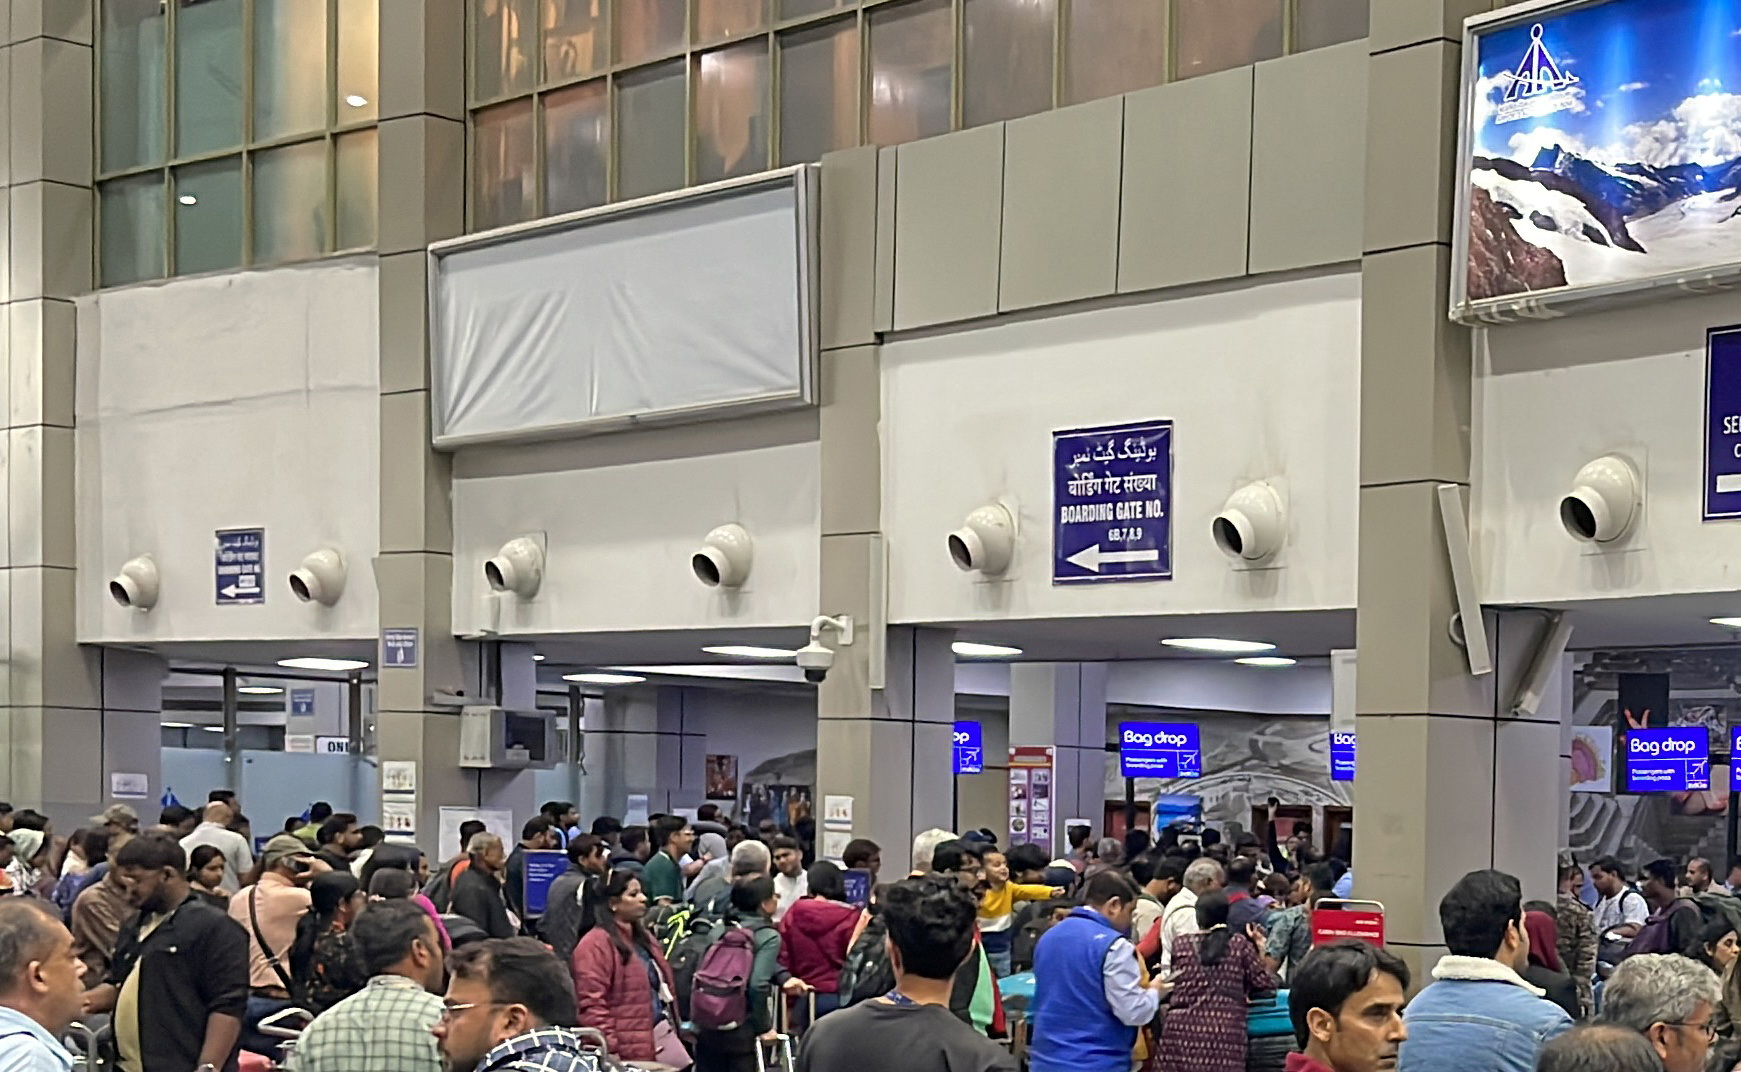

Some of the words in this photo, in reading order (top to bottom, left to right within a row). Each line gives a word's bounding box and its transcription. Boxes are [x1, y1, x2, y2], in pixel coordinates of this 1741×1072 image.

[1104, 471, 1122, 494] गेट
[1123, 471, 1157, 493] संख्या
[1061, 502, 1114, 524] BOARDING
[1116, 501, 1143, 521] GATE
[1145, 500, 1164, 518] NO.
[1123, 730, 1153, 746] Bag
[1154, 730, 1188, 747] drop
[1630, 738, 1659, 756] Bag
[1662, 737, 1695, 755] drop
